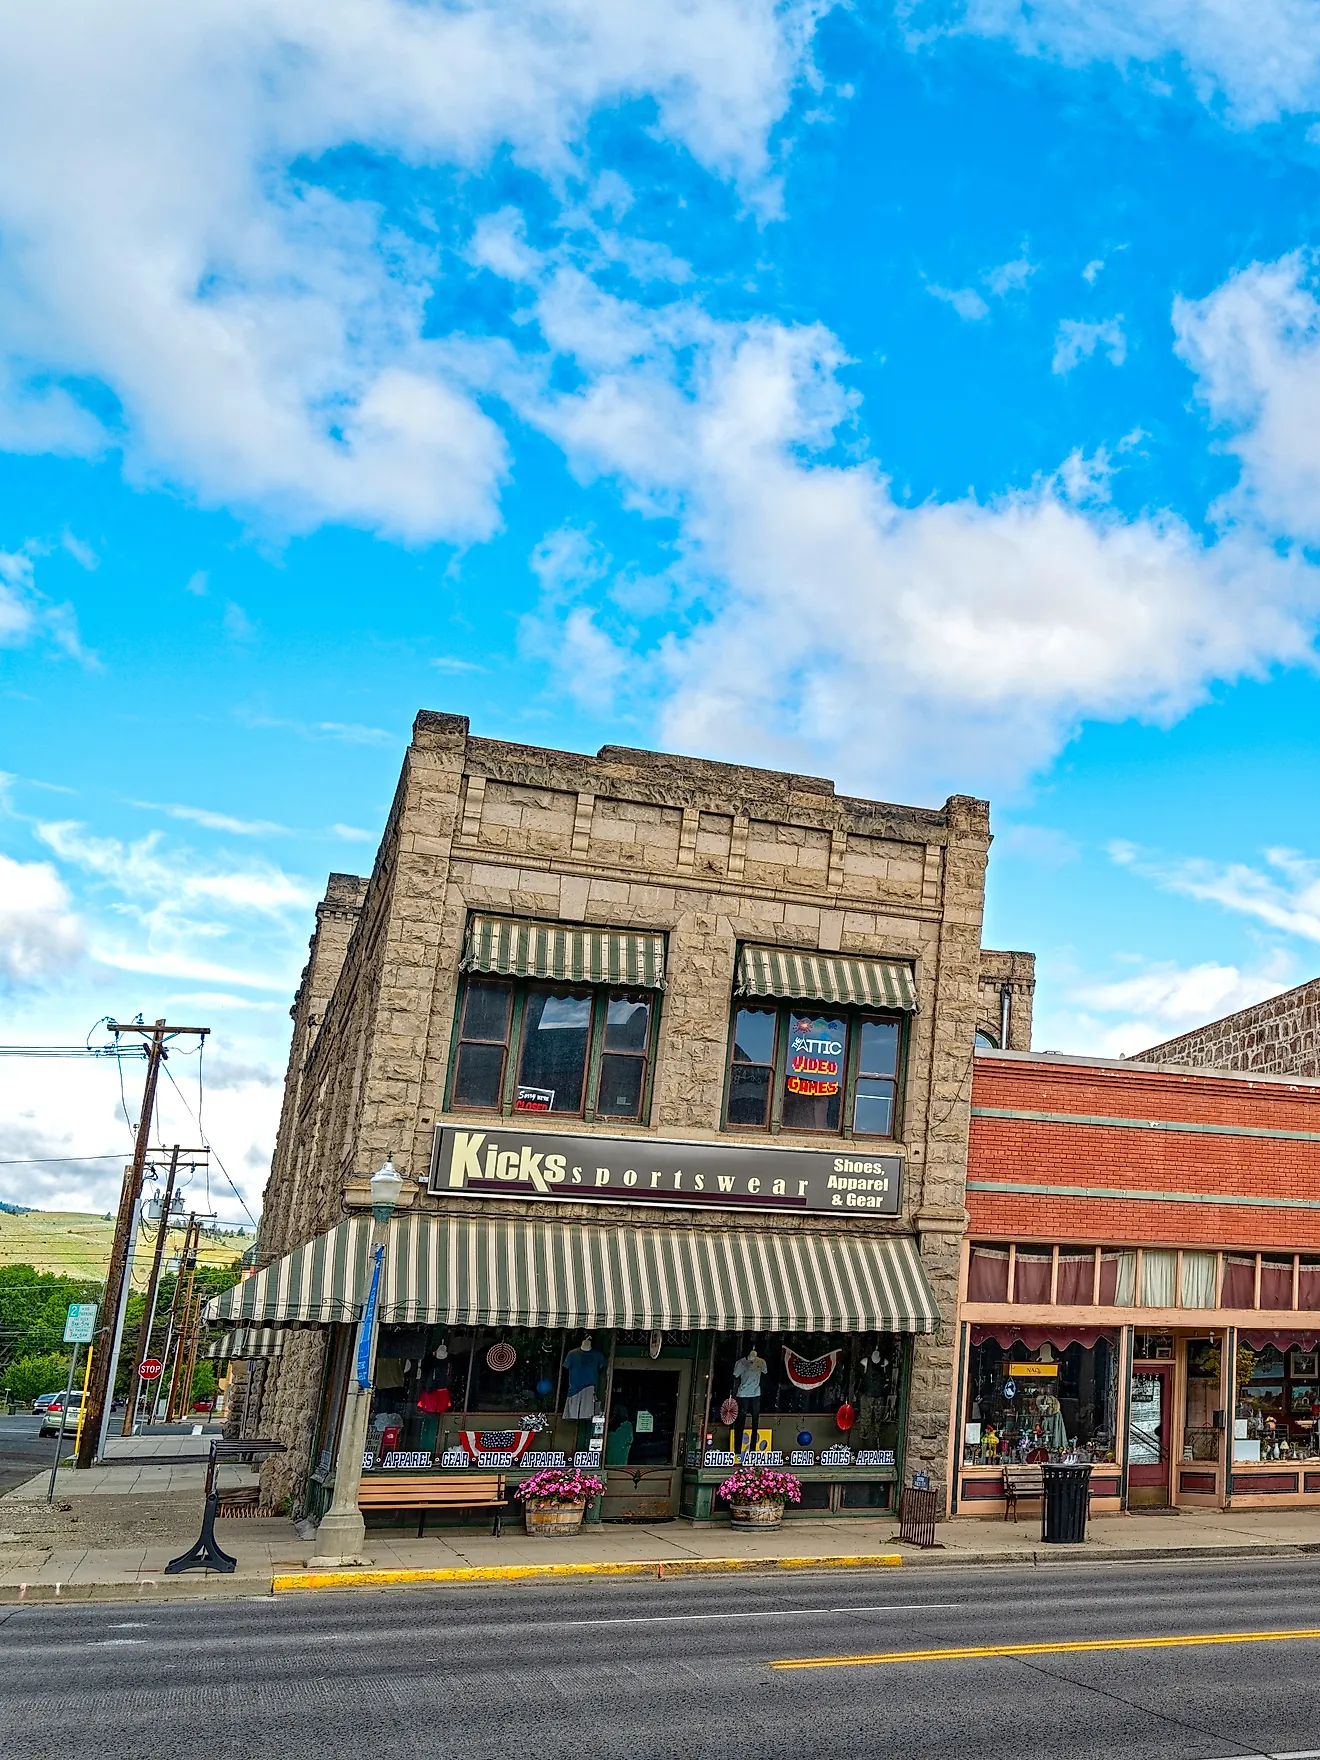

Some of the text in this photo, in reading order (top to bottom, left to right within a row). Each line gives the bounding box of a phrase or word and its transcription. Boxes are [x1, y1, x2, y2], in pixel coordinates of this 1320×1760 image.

[796, 1038, 842, 1056] ATTIC
[792, 1056, 838, 1075] VIDEO
[787, 1077, 839, 1096] GAMES
[449, 1132, 809, 1196] Kicks sportswear
[833, 1158, 886, 1176] Shoes,
[827, 1175, 889, 1192] Apparel
[831, 1192, 884, 1208] & Gear
[71, 1306, 78, 1316] 2
[141, 1365, 161, 1374] STOP
[382, 1451, 433, 1469] APPAREL
[441, 1451, 470, 1469] GEAR
[477, 1451, 513, 1468] SHOES
[519, 1451, 566, 1468] APPAREL
[573, 1451, 601, 1468] GEAR
[704, 1450, 896, 1467] SHOES APPAREL GEAR SHOES APPAREL
